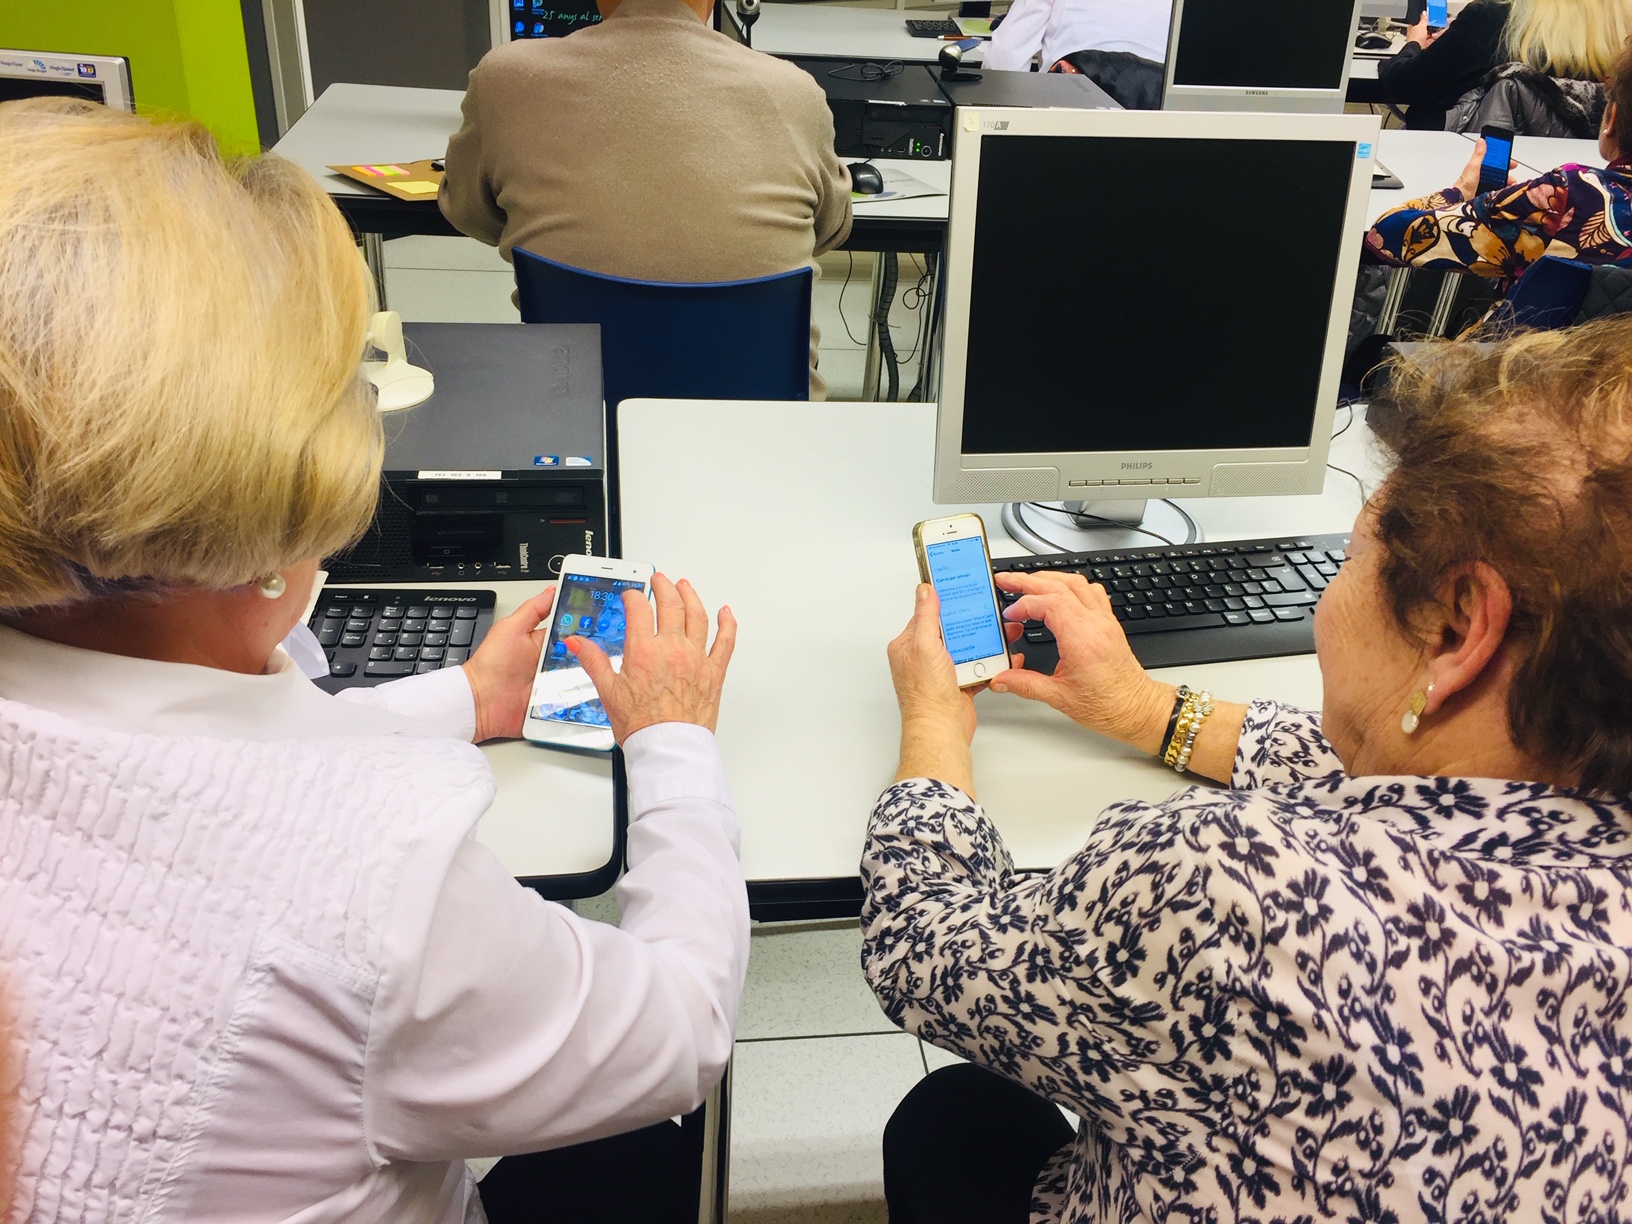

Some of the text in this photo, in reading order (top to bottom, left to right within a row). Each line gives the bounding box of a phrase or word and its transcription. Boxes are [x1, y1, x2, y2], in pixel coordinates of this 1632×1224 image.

[542, 10, 555, 20] 25
[558, 13, 578, 25] anys
[580, 11, 590, 20] al
[1120, 462, 1153, 470] PHILIPS
[590, 590, 614, 601] 18:30
